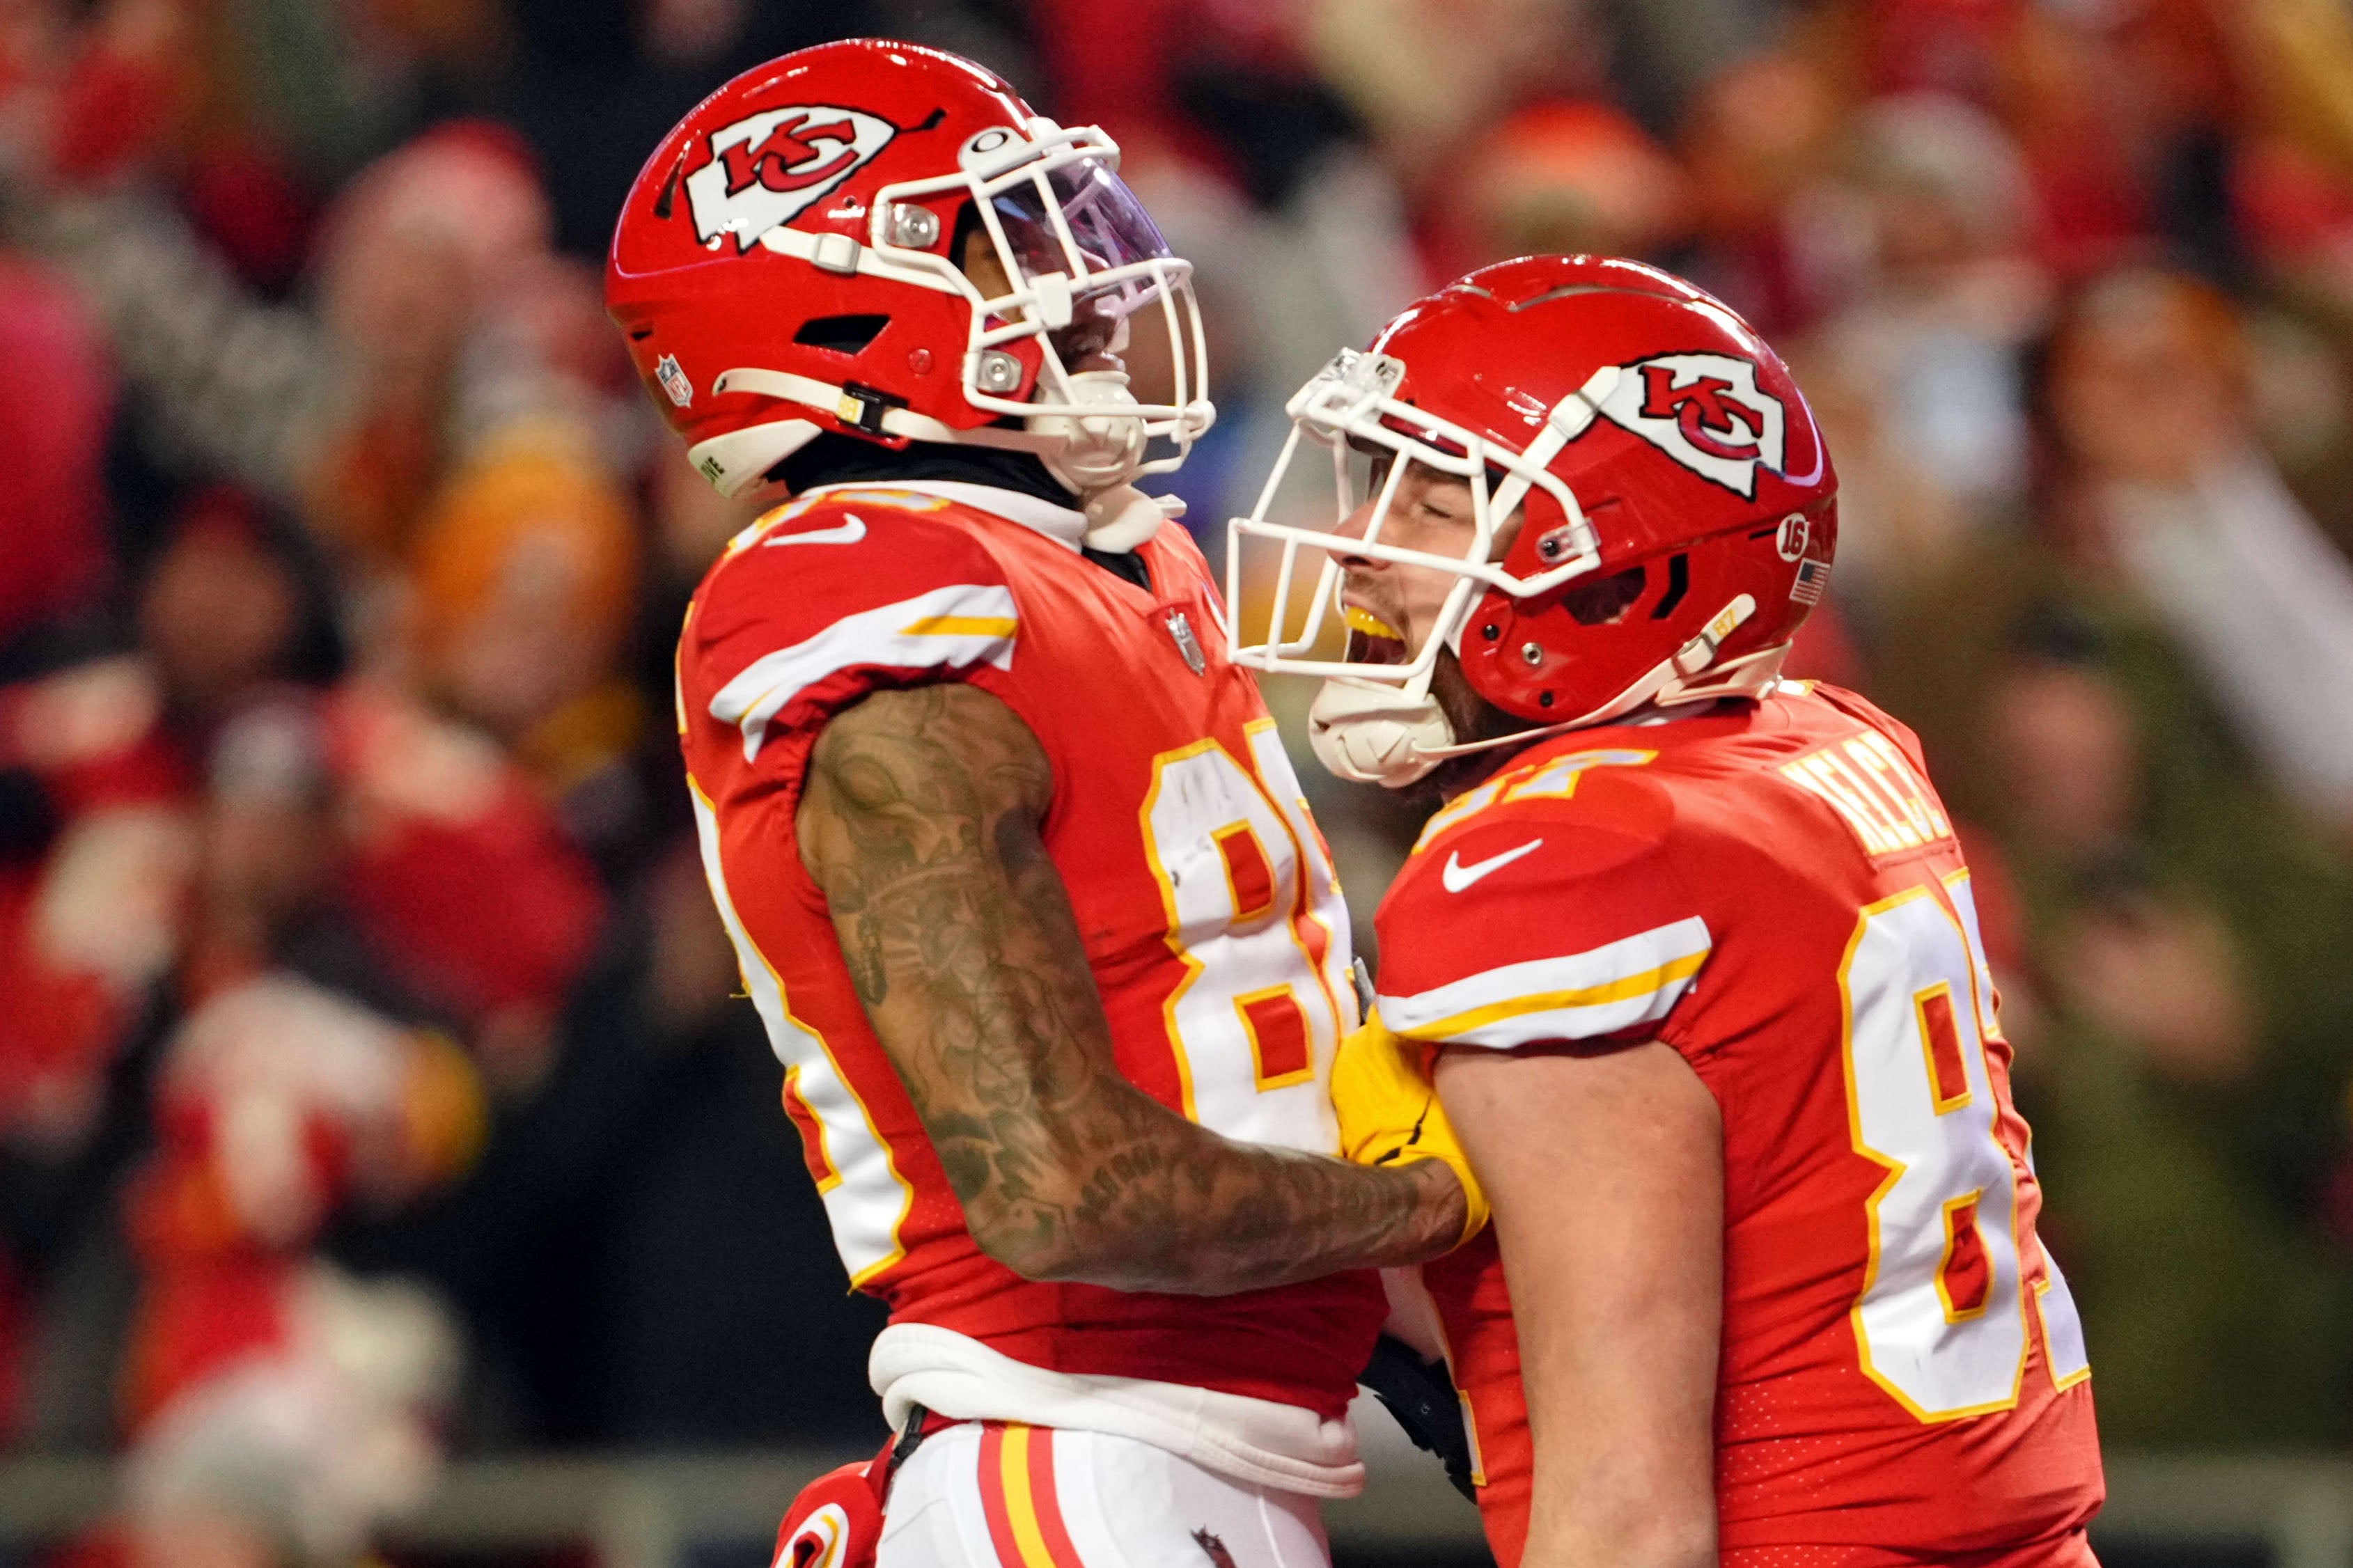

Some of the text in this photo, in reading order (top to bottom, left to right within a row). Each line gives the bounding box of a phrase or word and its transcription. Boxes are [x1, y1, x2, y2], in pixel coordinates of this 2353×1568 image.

[717, 113, 860, 198] KC
[1638, 364, 1764, 461] KC
[1781, 519, 1806, 555] 16
